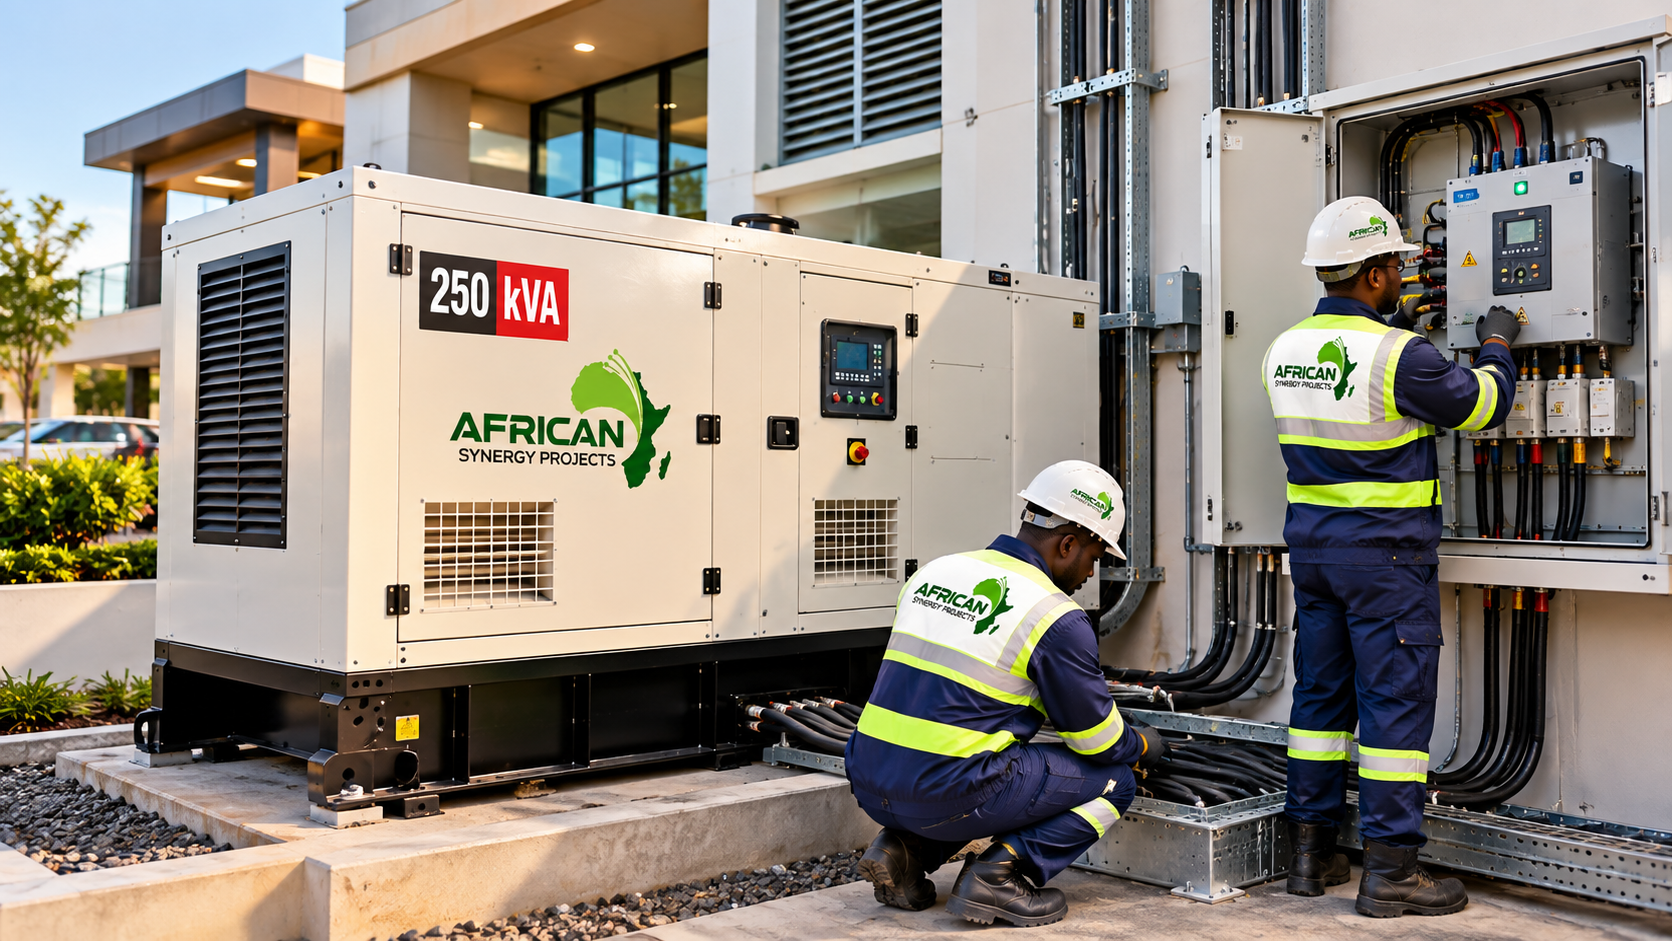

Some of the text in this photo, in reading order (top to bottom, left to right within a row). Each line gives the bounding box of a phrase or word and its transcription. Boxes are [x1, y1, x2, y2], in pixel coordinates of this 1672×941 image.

[430, 266, 561, 325] 250 kVA
[1274, 365, 1337, 381] AFRICAN
[450, 412, 624, 448] AFRICAN
[458, 448, 616, 467] SYNERGY PROJECTS
[914, 582, 989, 615] AFRICAN
